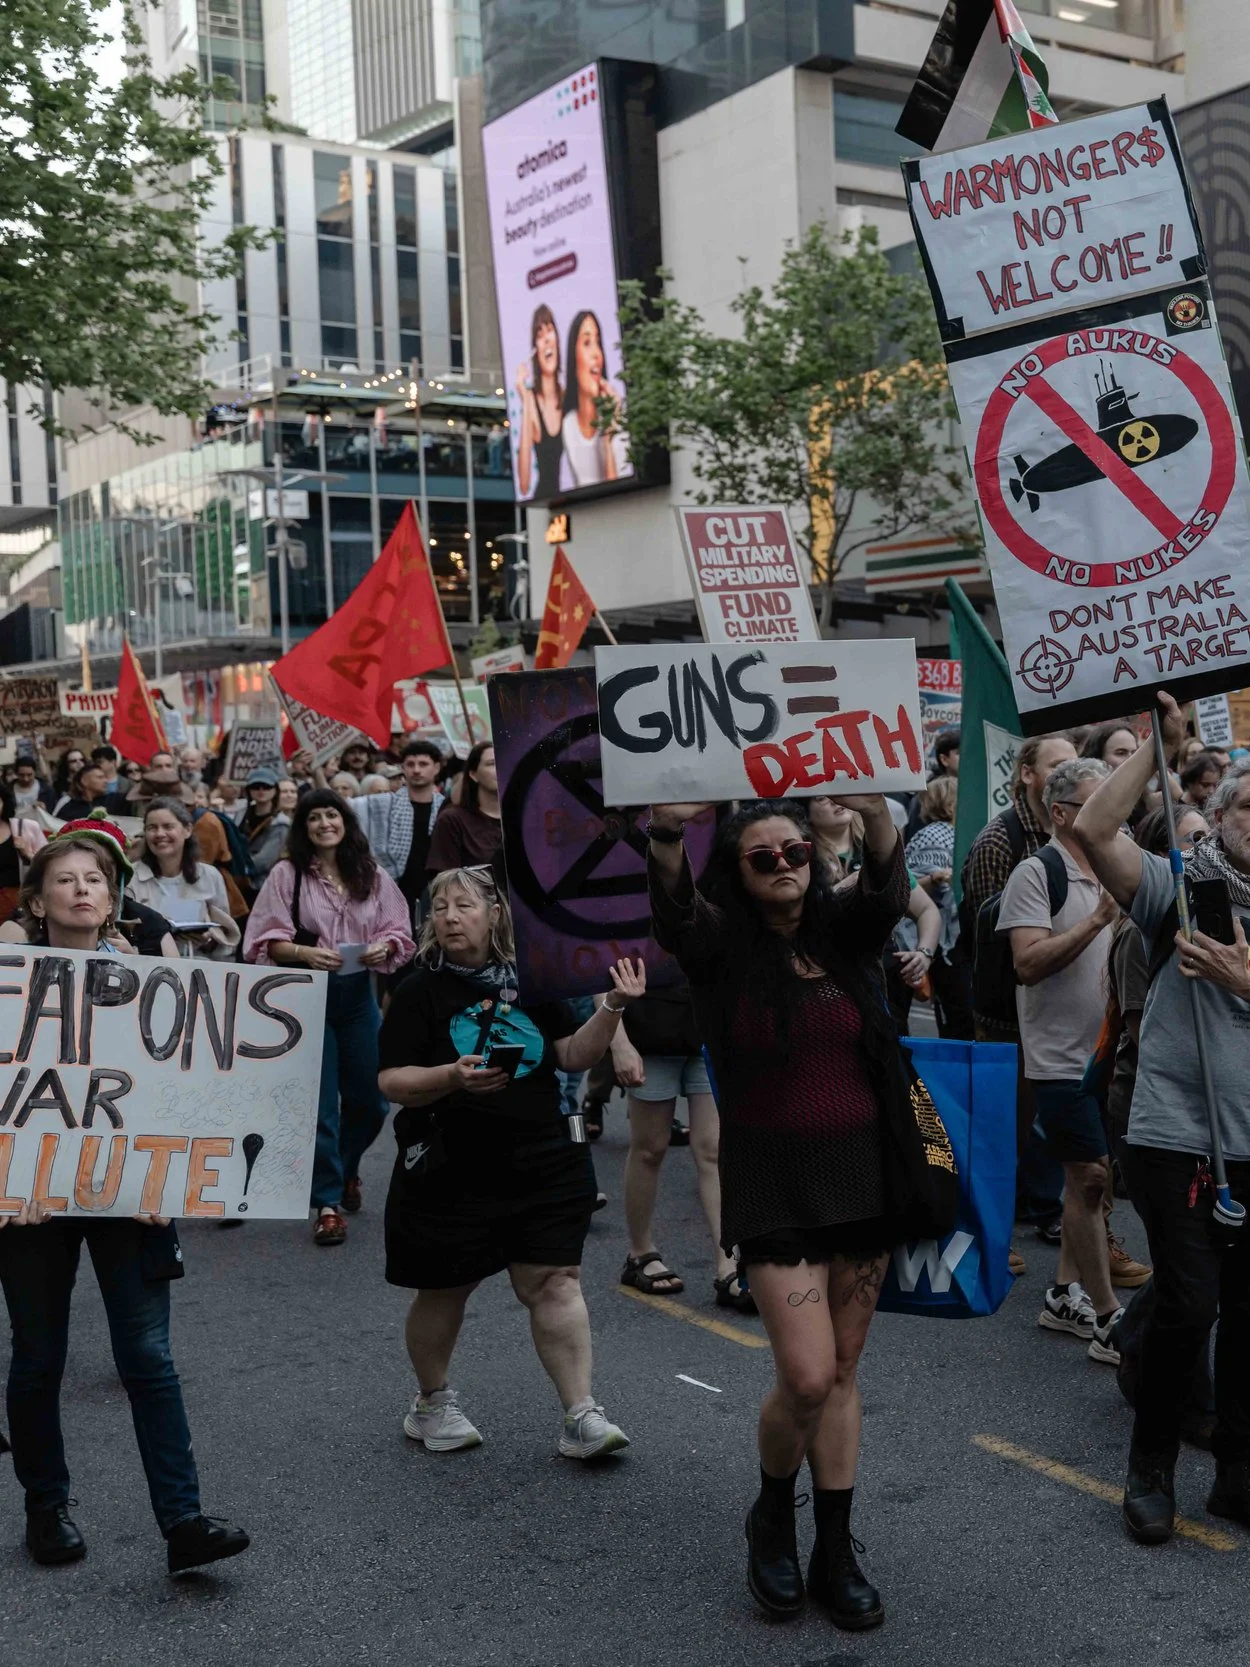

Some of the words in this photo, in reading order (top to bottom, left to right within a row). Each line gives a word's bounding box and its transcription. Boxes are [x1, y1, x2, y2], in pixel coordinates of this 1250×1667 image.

[517, 139, 568, 180] atomica
[919, 125, 1166, 221] WARMONGER$
[506, 182, 551, 217] Australia's
[552, 163, 588, 195] newest
[505, 217, 538, 246] beauty
[540, 192, 594, 229] destination
[1013, 194, 1092, 251] NOT
[999, 354, 1045, 399] NO
[1066, 328, 1178, 366] AUKUS
[705, 516, 767, 546] CUT
[1044, 555, 1091, 587] NO
[1115, 508, 1219, 585] NUKES
[699, 545, 786, 567] MILITARY
[700, 564, 798, 588] SPENDING
[718, 591, 792, 619] FUND
[724, 617, 799, 638] CLIMATE
[1049, 592, 1138, 634] DON'T
[1146, 575, 1235, 615] MAKE
[1077, 603, 1248, 661] AUSTRALIA
[1113, 655, 1138, 683] A
[65, 692, 117, 712] PRID
[598, 650, 779, 753] GUNS
[919, 698, 962, 721] BOYCOT
[236, 728, 274, 740] FUND
[742, 705, 922, 798] DEATH
